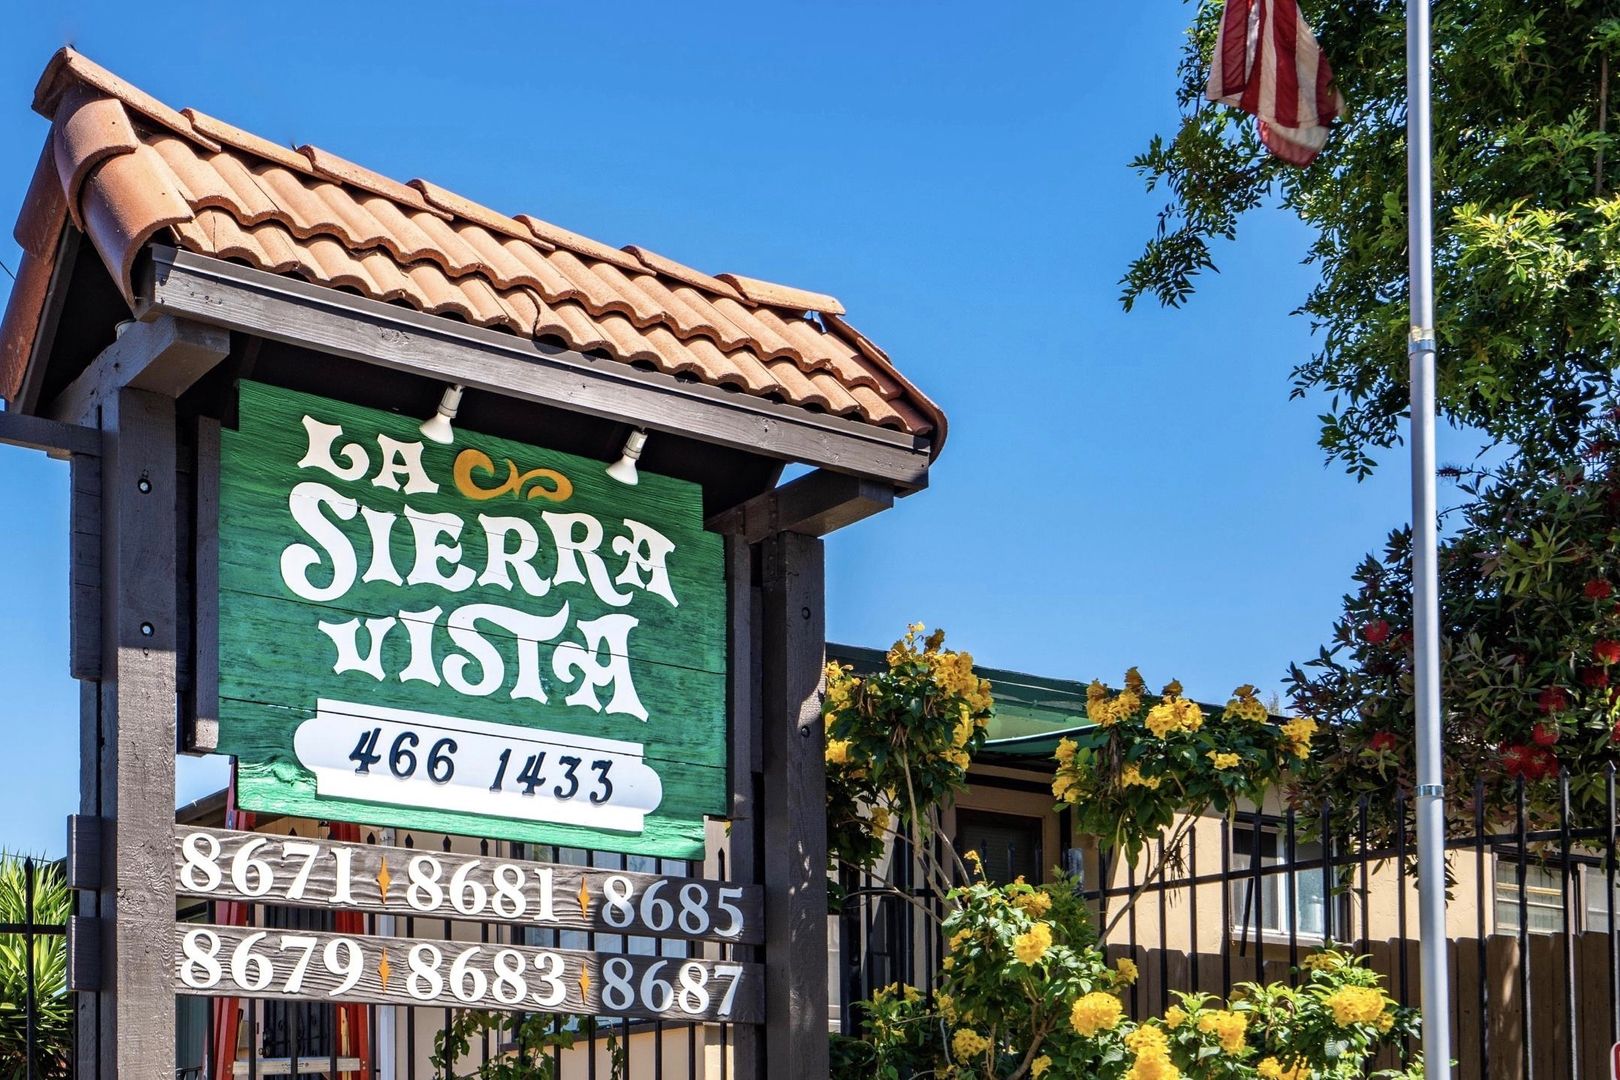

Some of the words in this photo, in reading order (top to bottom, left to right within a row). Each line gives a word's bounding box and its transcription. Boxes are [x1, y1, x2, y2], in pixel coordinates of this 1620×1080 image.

[297, 414, 440, 495] LA
[280, 481, 680, 608] SIERRA
[318, 600, 649, 722] VISTA
[349, 727, 458, 785] 466
[489, 748, 613, 805] 1433
[180, 832, 359, 906] 8671
[407, 855, 559, 922] 8681
[601, 875, 744, 938] 8685
[180, 929, 364, 997] 8679
[405, 943, 566, 1007] 8683
[601, 957, 744, 1017] 8687
